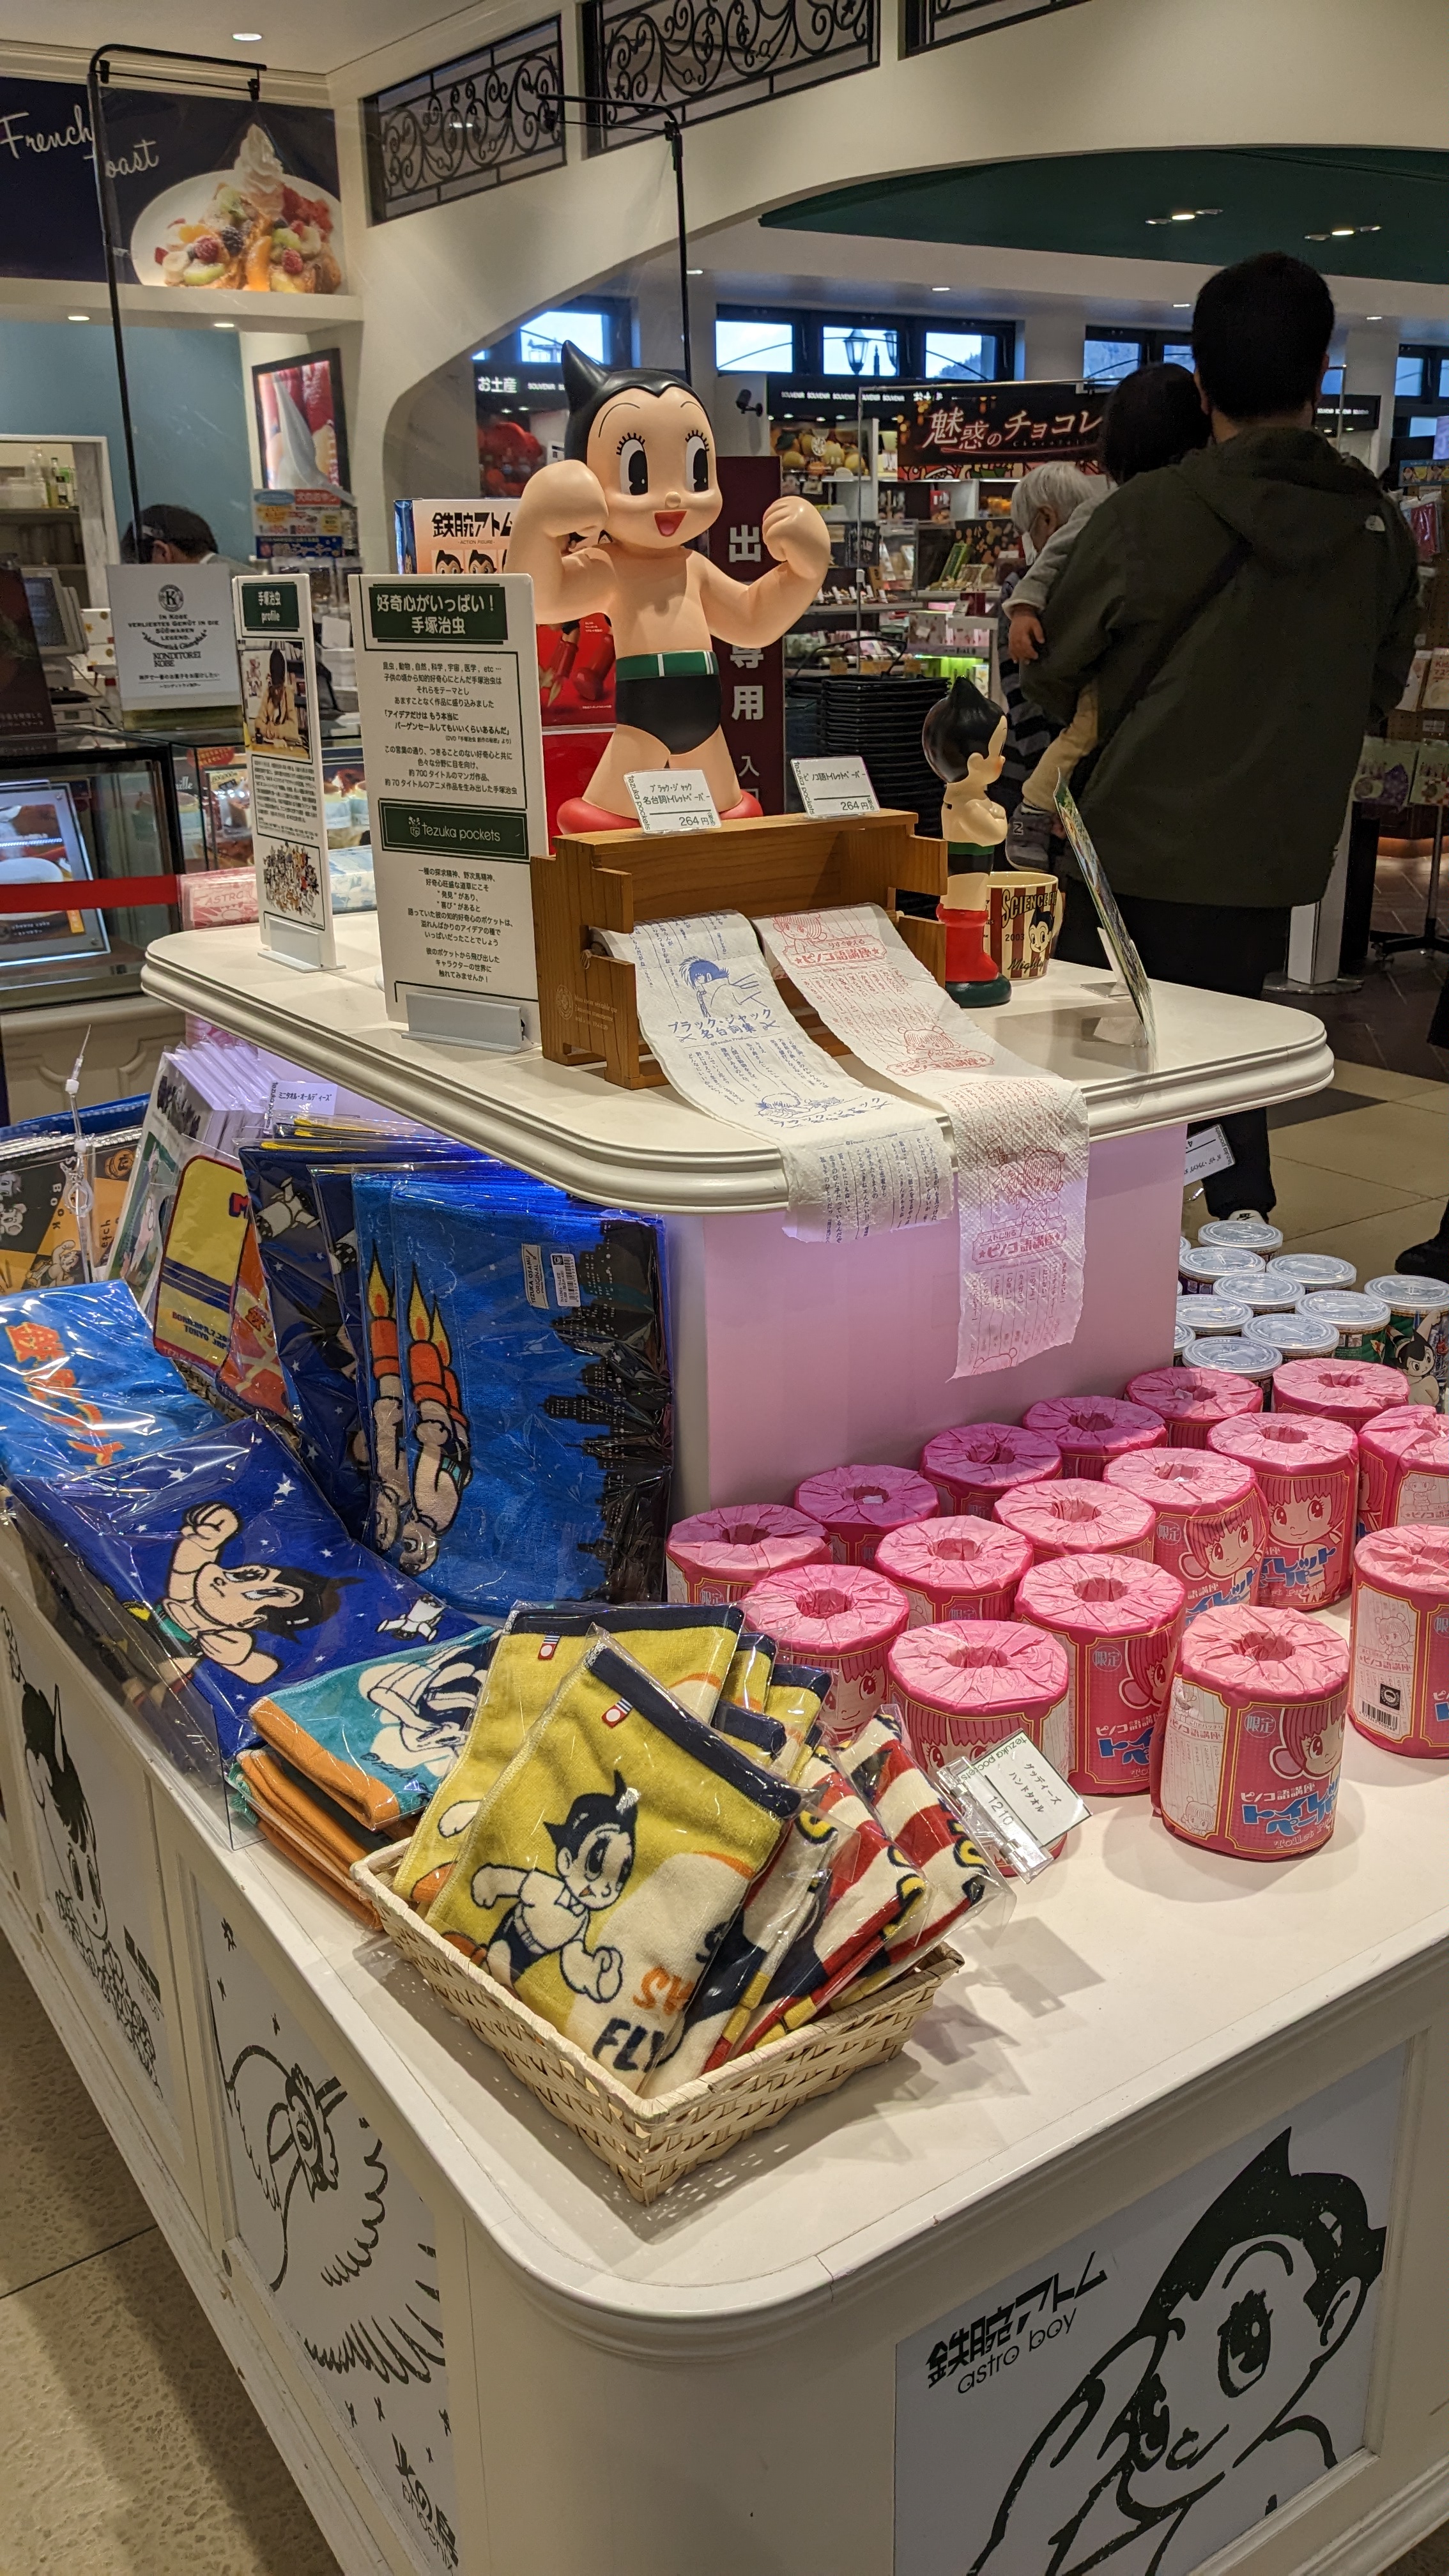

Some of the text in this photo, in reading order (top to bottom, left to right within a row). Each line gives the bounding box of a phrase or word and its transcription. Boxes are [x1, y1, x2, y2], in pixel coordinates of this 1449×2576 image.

[0, 105, 93, 159] French
[478, 376, 518, 394] お土産
[258, 591, 281, 607] 手塚治虫
[376, 593, 495, 613] 好奇心がいっぱい！
[261, 610, 280, 622] profile
[411, 616, 466, 635] 手塚治虫
[417, 686, 470, 695] それらをテーマとし
[793, 761, 815, 815] tezuka pockets
[627, 775, 650, 831] tezuka pockets
[422, 824, 501, 842] tezuka pockets
[1001, 889, 1049, 928] SCIENCE
[1005, 933, 1025, 942] 2003
[1007, 956, 1045, 974] Mighty
[668, 1008, 771, 1034] ブラック・ジャック
[702, 1022, 757, 1040] 名台詞集
[528, 1280, 536, 1303] TEZUKA
[1157, 1524, 1181, 1537] 限定
[1093, 1651, 1120, 1667] 限定
[1246, 1715, 1275, 1734] 限定
[995, 1735, 1028, 1759] tezuka
[1009, 1772, 1044, 1813] ハンドタオル
[1241, 1782, 1315, 1802] ピノコ語講座
[1274, 1822, 1314, 1849] Toilet
[924, 2250, 1108, 2389] 鉄腕アトム
[957, 2307, 1078, 2395] astro boy
